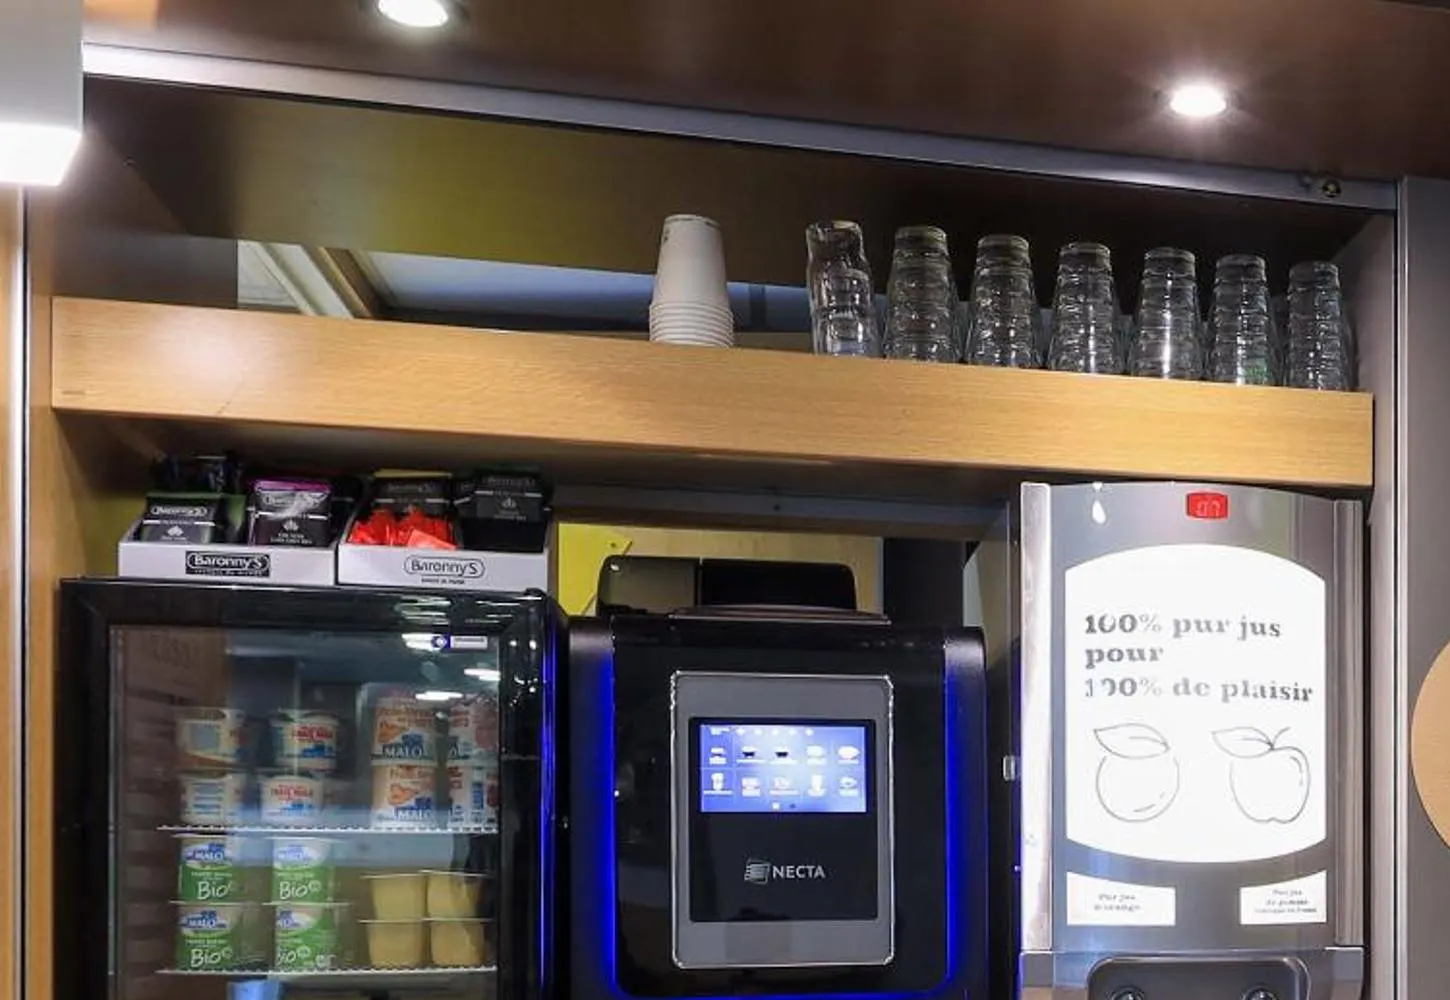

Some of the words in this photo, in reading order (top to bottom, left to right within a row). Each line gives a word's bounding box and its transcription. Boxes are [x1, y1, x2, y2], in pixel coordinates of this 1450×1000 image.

[1085, 613, 1163, 634] 100%
[1172, 617, 1230, 639] pur
[1237, 615, 1281, 641] jus
[1085, 646, 1164, 670] pour
[1172, 677, 1211, 697] de
[1220, 680, 1313, 703] plaisir
[772, 865, 826, 879] NECTA
[279, 880, 308, 900] Bio
